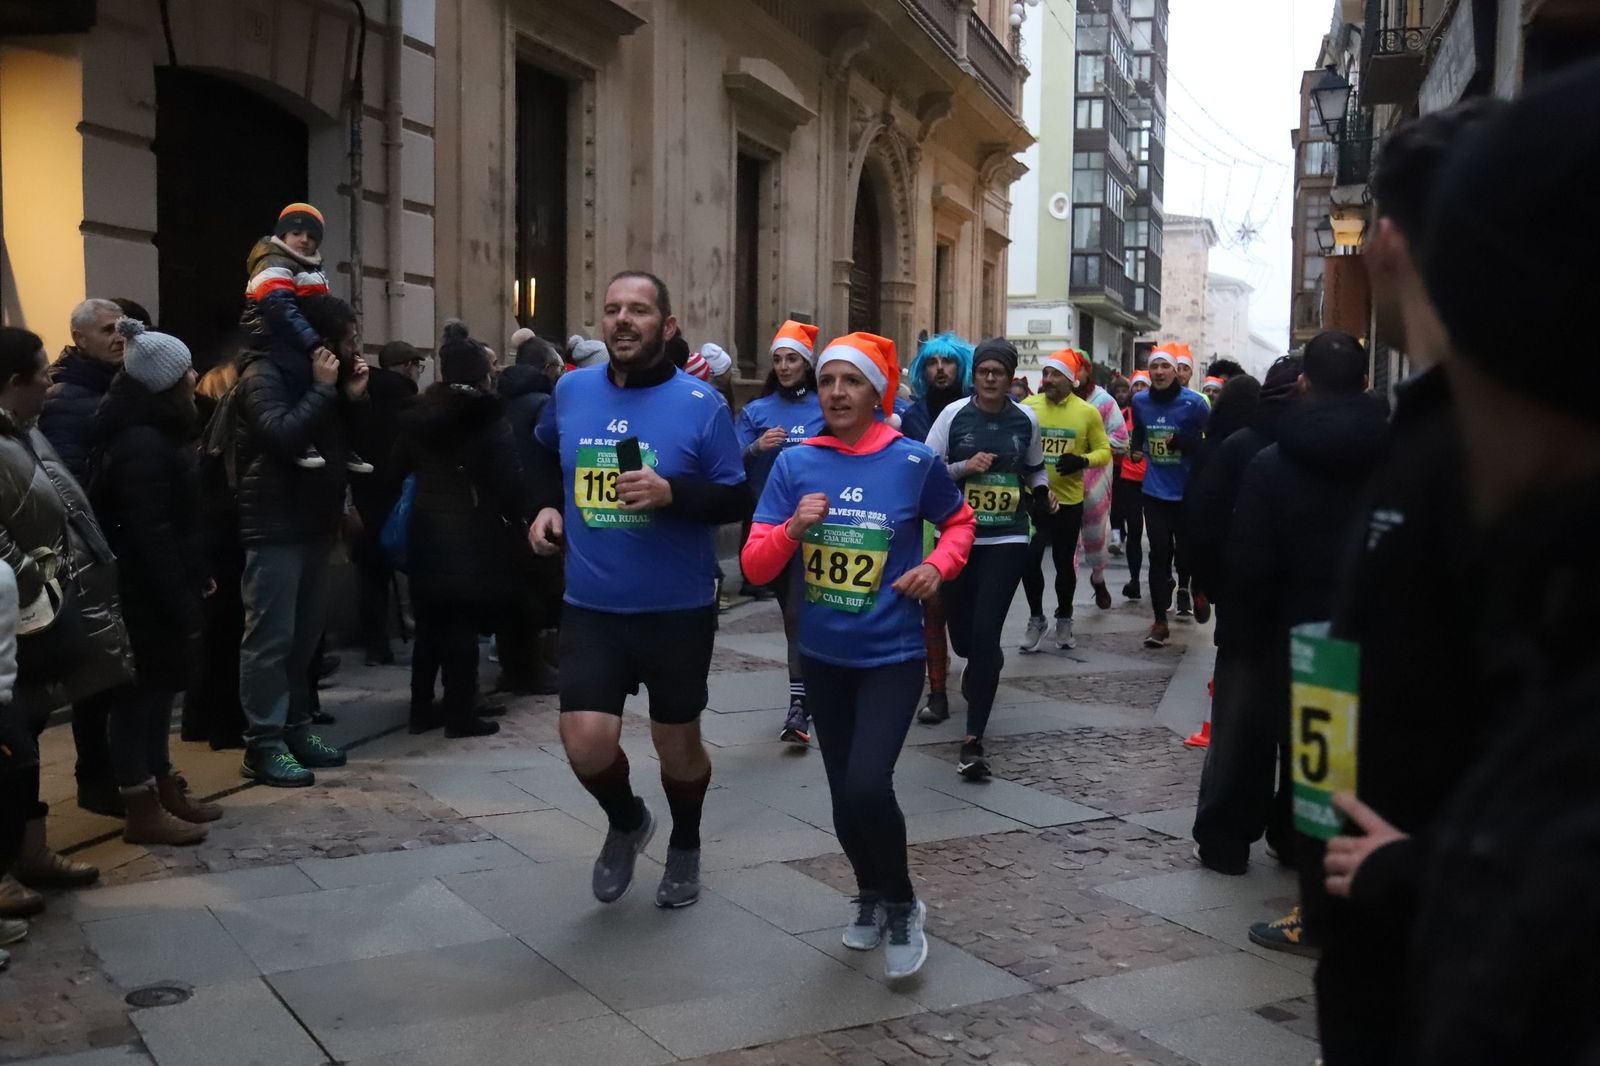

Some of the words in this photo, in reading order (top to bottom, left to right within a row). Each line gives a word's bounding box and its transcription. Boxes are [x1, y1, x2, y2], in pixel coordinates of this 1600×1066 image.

[606, 418, 629, 434] 46
[791, 425, 805, 434] 46
[579, 437, 593, 445] SAN
[1041, 437, 1068, 454] 1217
[583, 470, 620, 502] 113
[839, 486, 864, 502] 46
[966, 488, 1012, 511] 533
[594, 513, 617, 523] CAJA
[867, 511, 887, 521] 2025
[807, 548, 874, 587] 482
[822, 592, 845, 605] CAJA
[1300, 705, 1332, 784] 5
